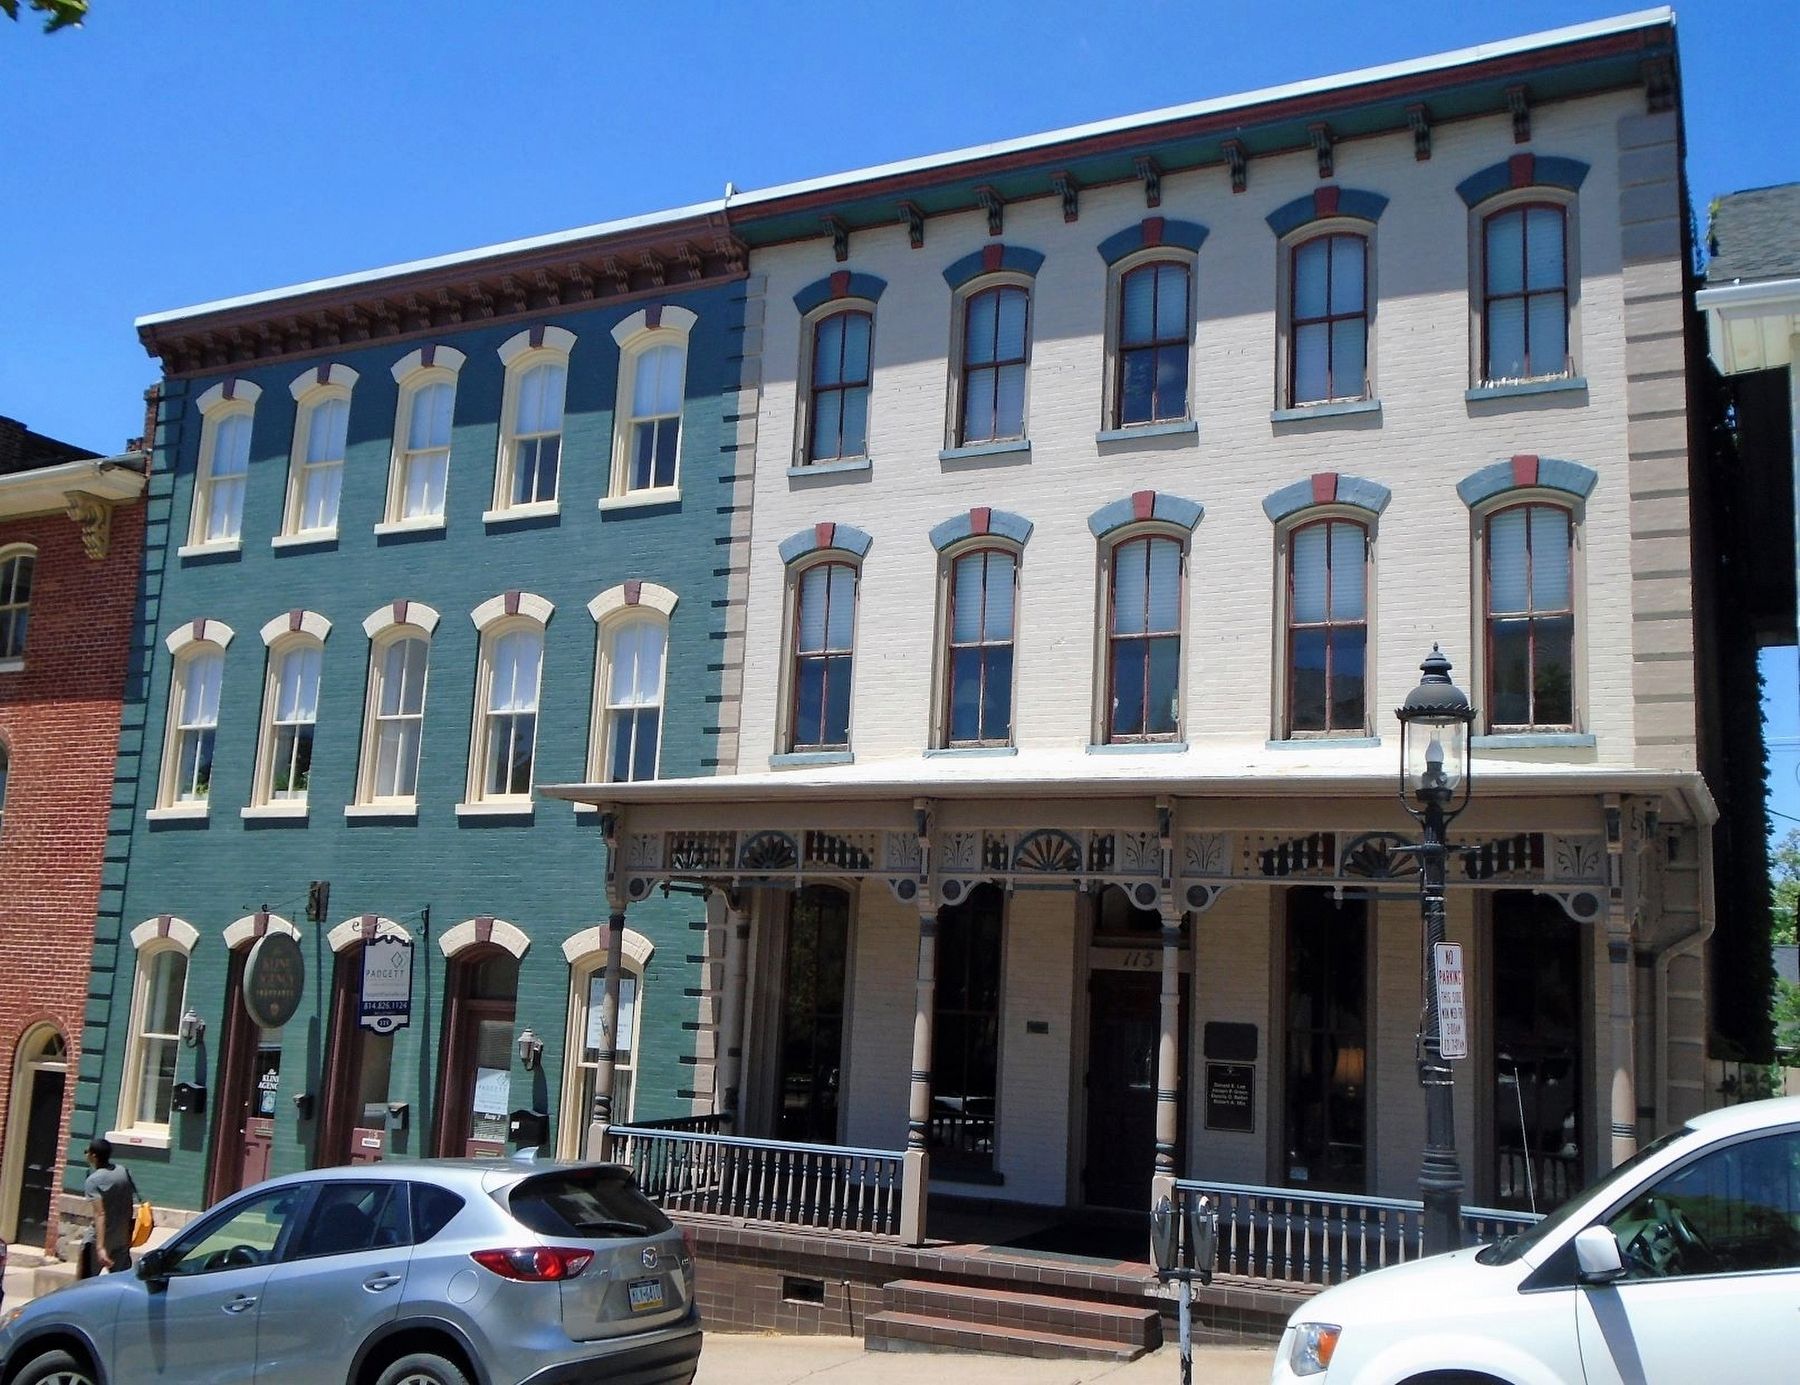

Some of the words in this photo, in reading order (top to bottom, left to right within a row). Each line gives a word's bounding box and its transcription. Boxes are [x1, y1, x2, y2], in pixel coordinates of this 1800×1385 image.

[1123, 952, 1154, 967] 115
[1445, 950, 1454, 965] NO
[366, 969, 404, 978] PADGETT
[1439, 970, 1462, 985] PARKING
[262, 1074, 280, 1083] KLIN
[257, 1081, 279, 1090] AGENC
